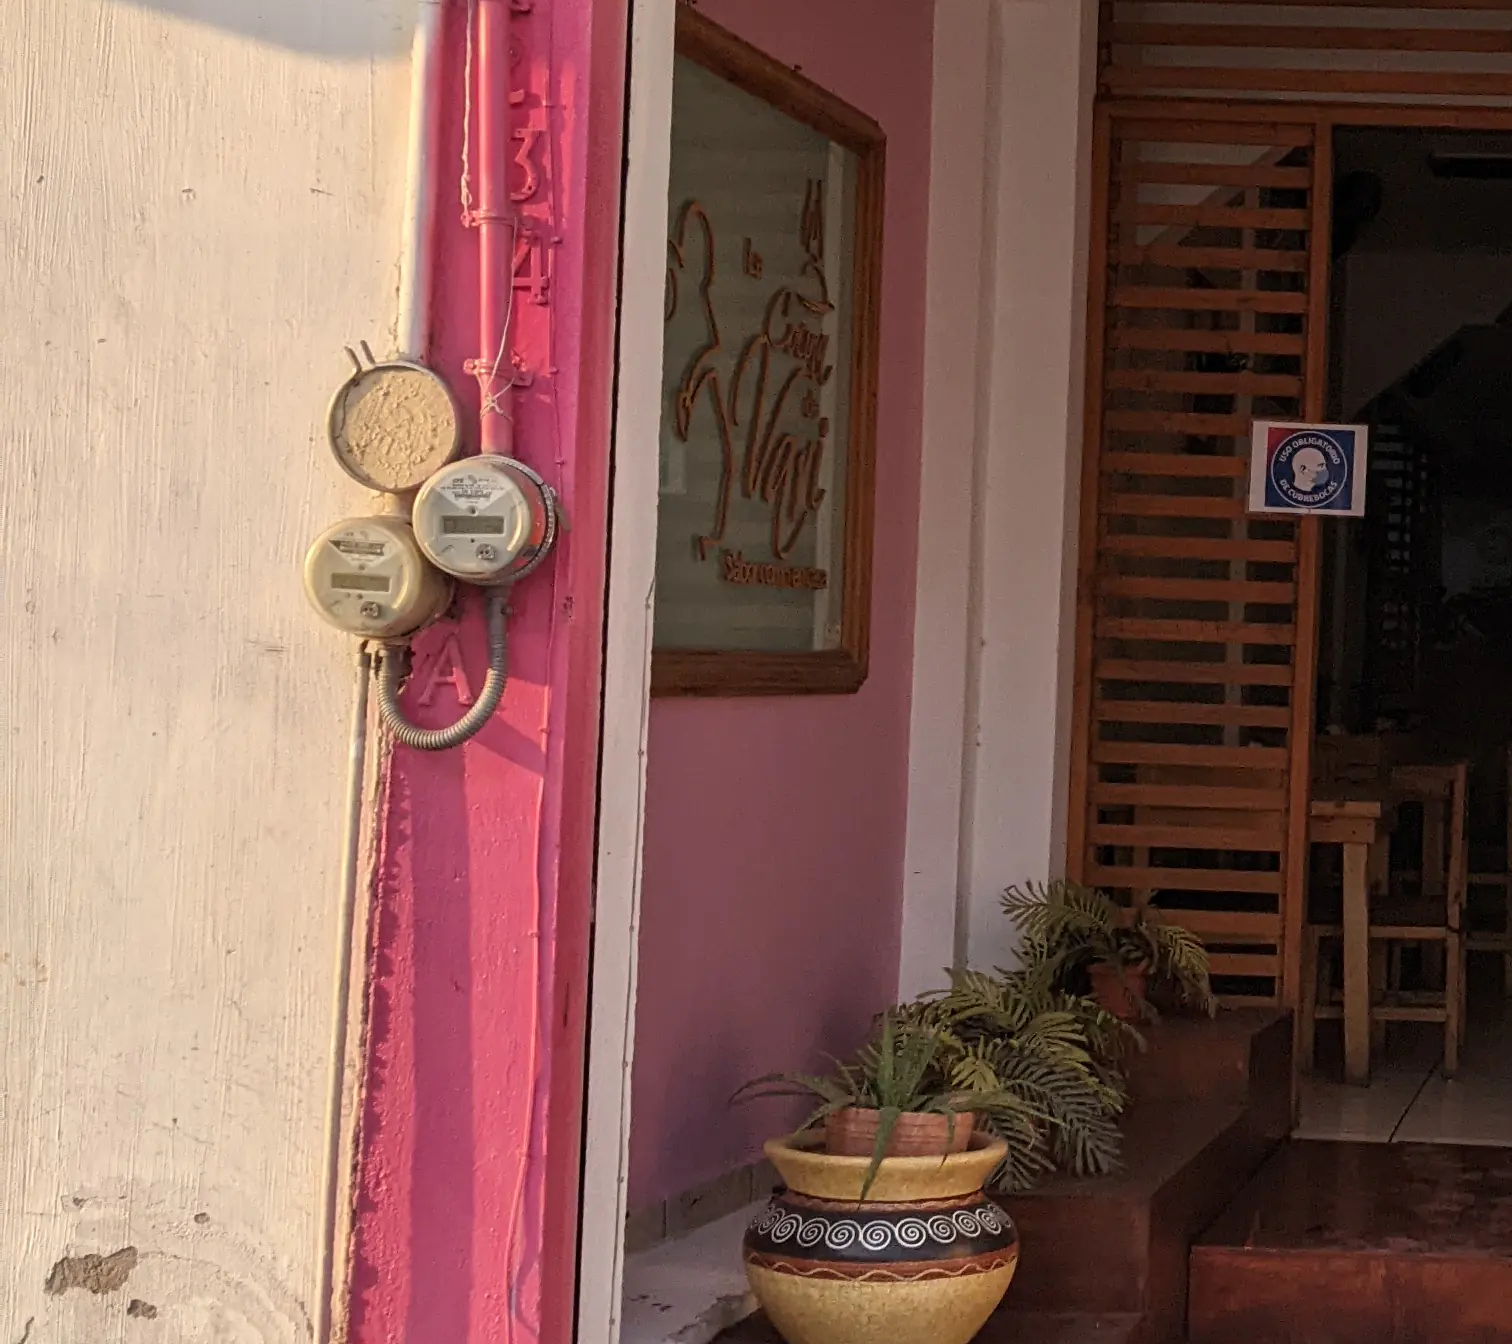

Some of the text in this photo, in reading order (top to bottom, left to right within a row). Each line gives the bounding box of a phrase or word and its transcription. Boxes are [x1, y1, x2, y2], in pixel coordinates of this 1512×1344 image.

[1280, 437, 1340, 464] USO OBLIGATORIO
[1280, 479, 1289, 491] DE
